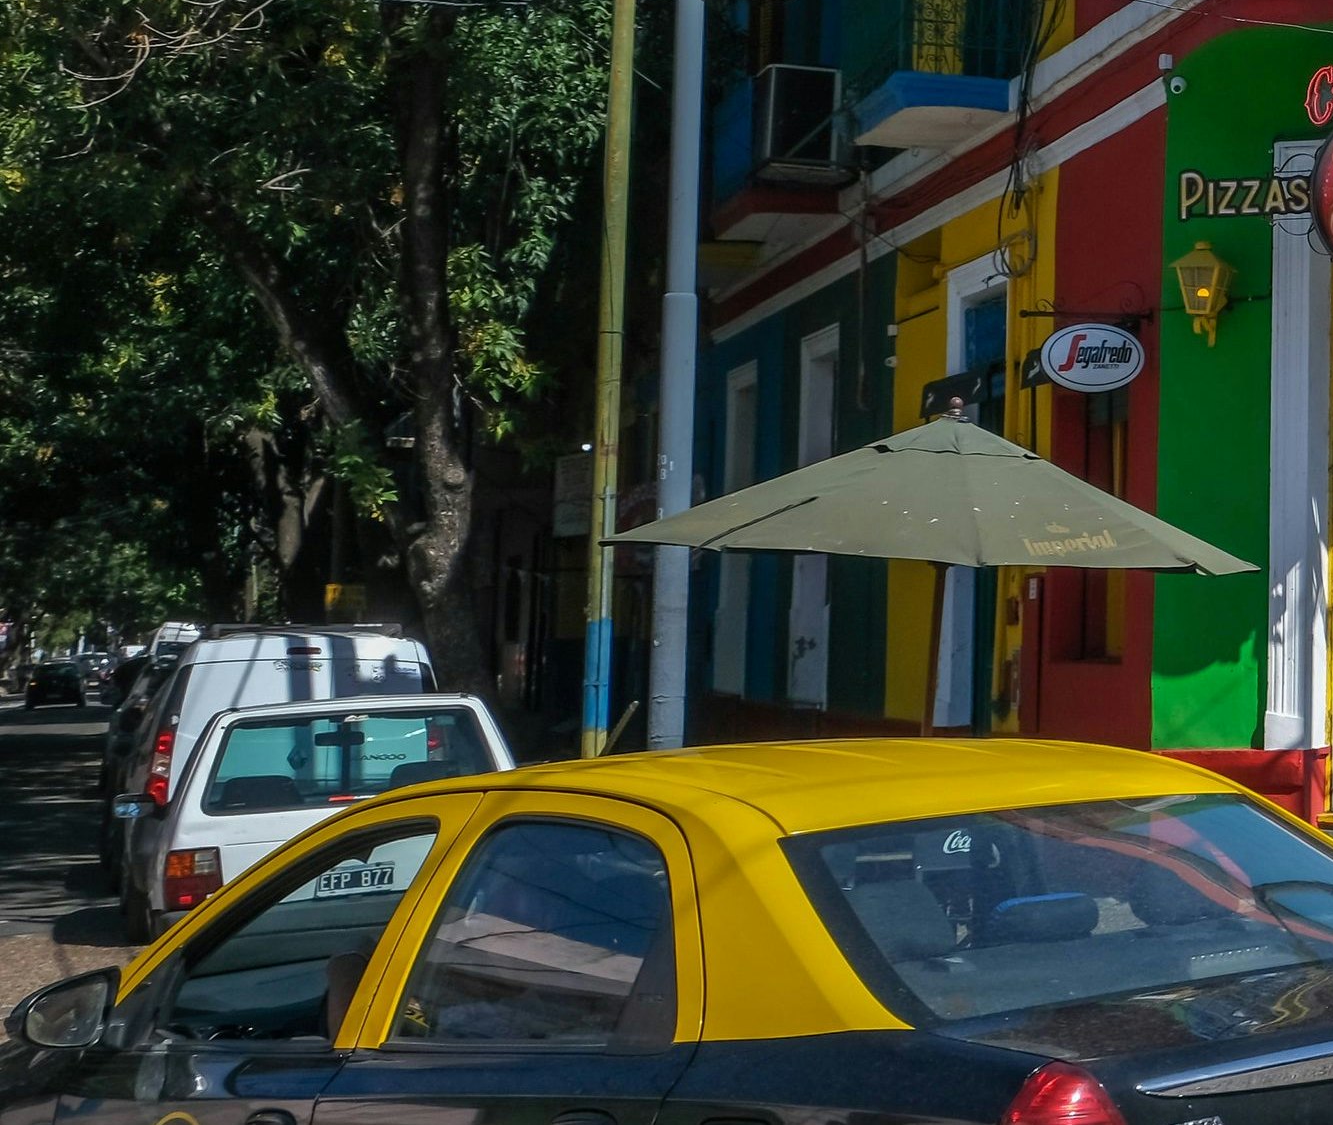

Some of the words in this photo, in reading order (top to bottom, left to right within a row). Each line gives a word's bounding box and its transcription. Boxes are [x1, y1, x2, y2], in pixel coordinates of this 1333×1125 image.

[1179, 172, 1309, 219] PIZZAS
[1058, 334, 1132, 372] Segafredo
[1022, 529, 1117, 557] Imperial
[320, 874, 351, 891] EFP
[361, 869, 392, 886] 877
